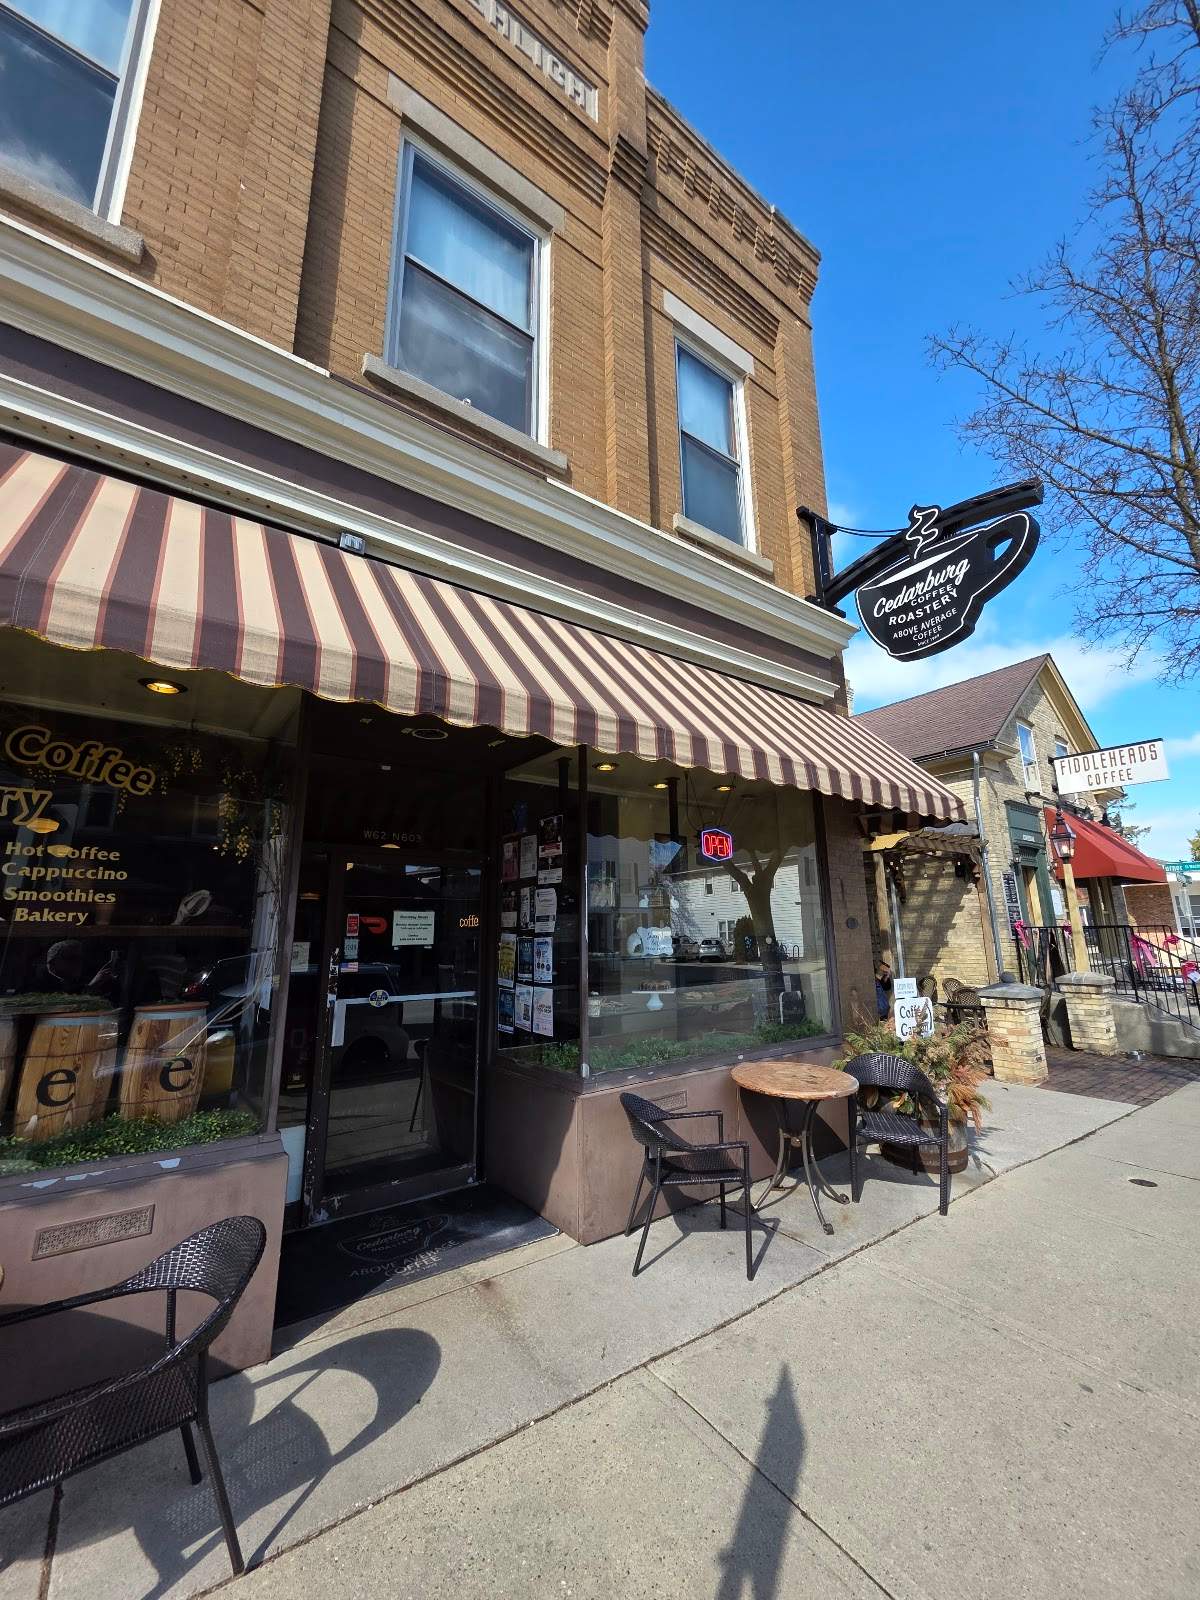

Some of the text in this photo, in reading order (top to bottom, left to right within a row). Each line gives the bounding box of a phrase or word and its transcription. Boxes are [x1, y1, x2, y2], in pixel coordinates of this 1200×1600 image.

[873, 558, 971, 618] Cedarburg
[911, 583, 954, 606] COFFEE
[888, 589, 959, 626] ROASTERY
[892, 607, 958, 640] ABOVE AVERAGE
[912, 624, 943, 642] COFFEE
[5, 724, 156, 796] Coffee
[1060, 743, 1158, 776] FIDDLEHEADS
[1087, 768, 1134, 787] COFFEE
[5, 841, 121, 861] Hot offee
[703, 834, 731, 857] OPEN
[1, 862, 128, 881] Cappuccino
[3, 886, 117, 904] Smoothies
[14, 908, 89, 926] Bakery
[385, 1254, 442, 1277] COFFEE
